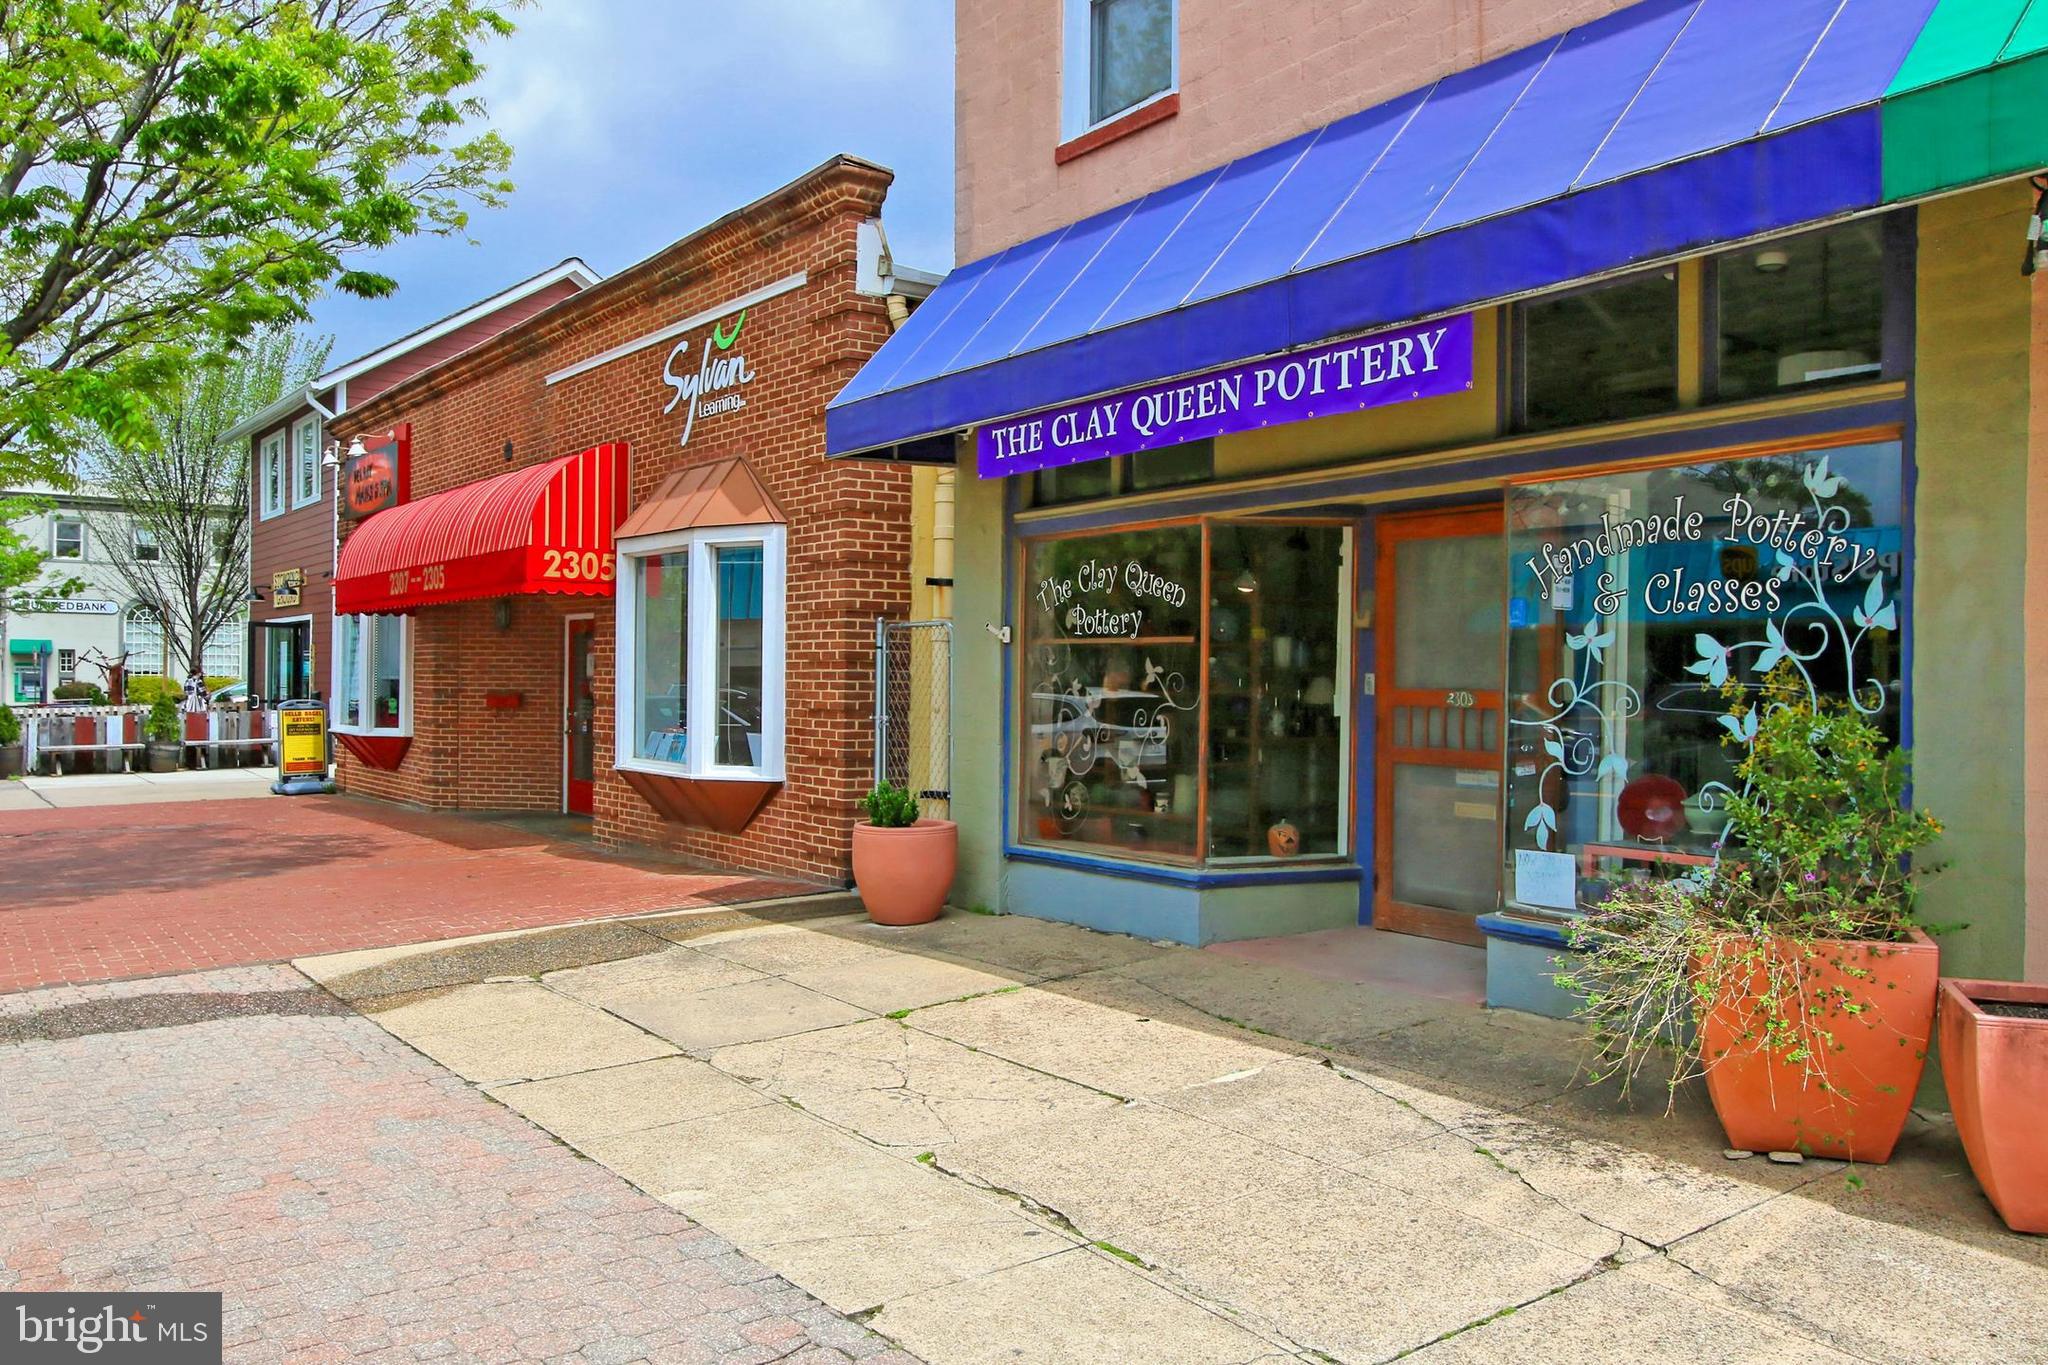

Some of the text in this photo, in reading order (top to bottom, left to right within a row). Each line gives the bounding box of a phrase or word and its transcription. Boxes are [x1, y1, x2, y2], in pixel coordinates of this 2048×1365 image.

[663, 337, 755, 447] Sylvan
[698, 394, 741, 418] Learning
[992, 328, 1448, 460] THE CLAY QUEEN POTTERY
[543, 550, 616, 581] 2305
[1525, 492, 1875, 601] Handmade Pottery
[423, 564, 445, 591] 2305
[1036, 559, 1186, 613] The Clay Queen
[1593, 568, 1781, 616] & Classes
[31, 601, 107, 612] UED BANK
[1072, 604, 1143, 639] Pottery
